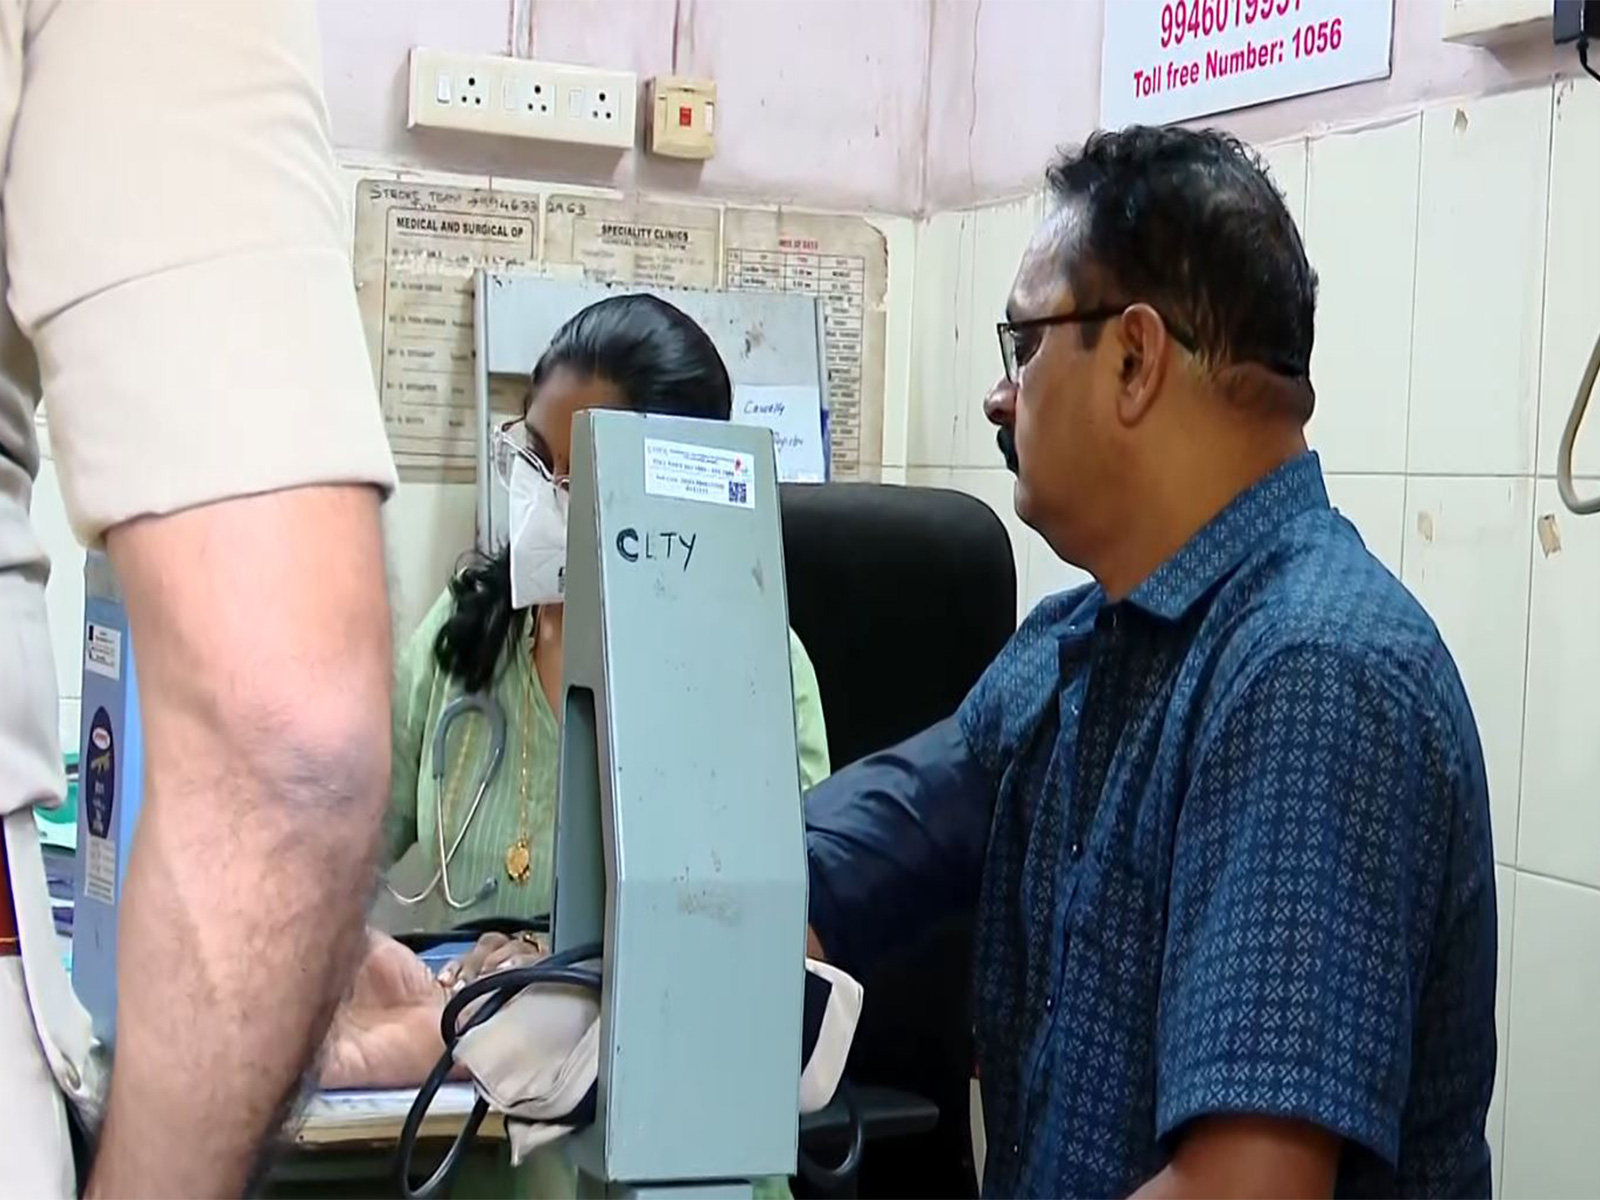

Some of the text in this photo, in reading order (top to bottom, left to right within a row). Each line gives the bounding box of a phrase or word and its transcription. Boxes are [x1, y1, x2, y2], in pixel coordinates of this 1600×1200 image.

[1160, 0, 1301, 48] 9946019
[1133, 18, 1343, 98] Toll free Number: 1056
[396, 216, 524, 238] MEDICAL AND SURGICAL OP
[601, 224, 689, 242] SPECIALITY CLINICS
[616, 527, 697, 572] CLTY
